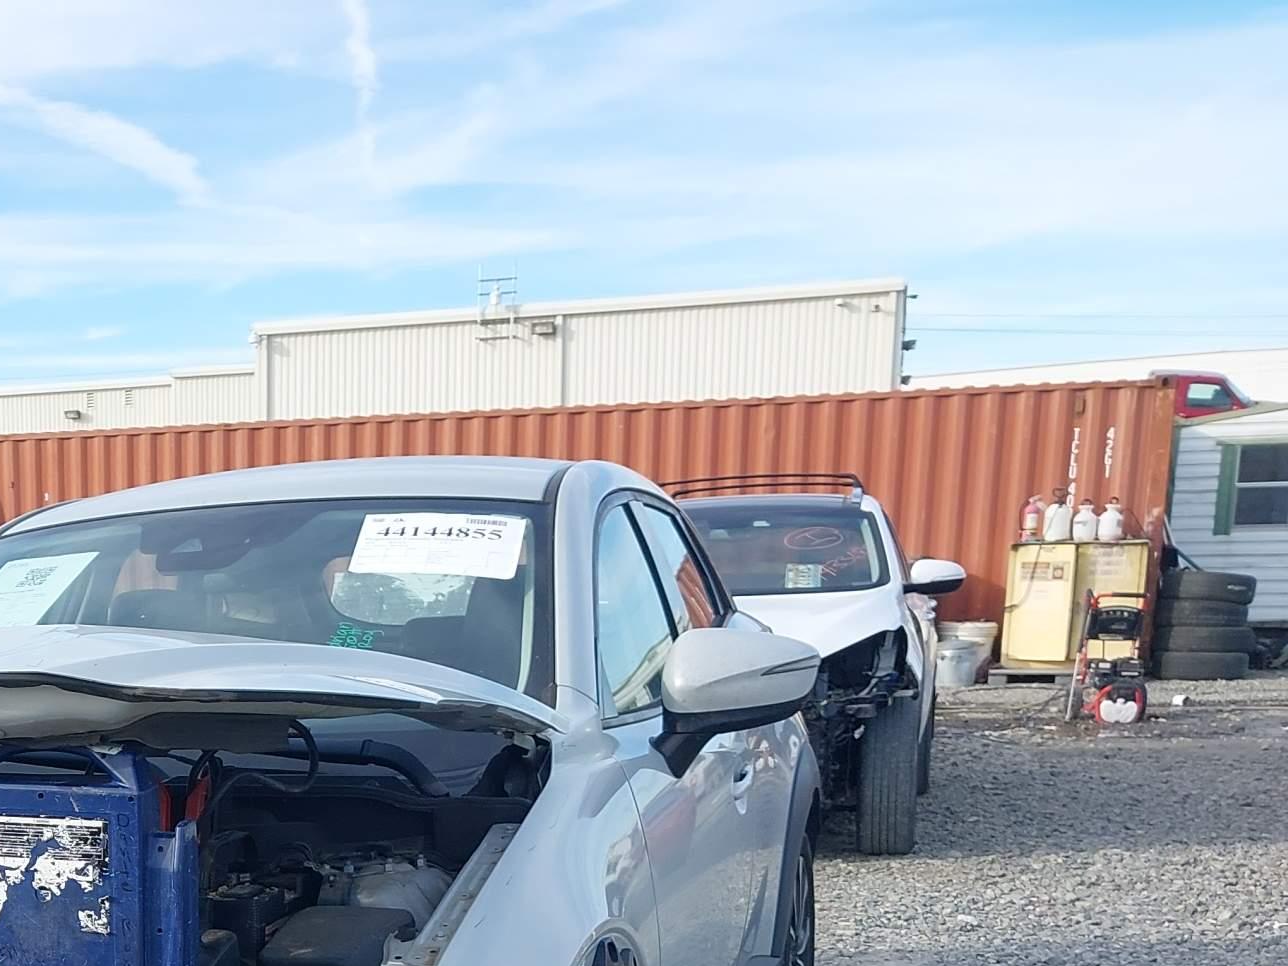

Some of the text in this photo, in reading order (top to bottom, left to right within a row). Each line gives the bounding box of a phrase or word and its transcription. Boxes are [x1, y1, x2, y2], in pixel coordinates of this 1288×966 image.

[1069, 427, 1081, 479] TCLU
[1104, 427, 1115, 478] 42G1
[376, 526, 503, 541] 44144855
